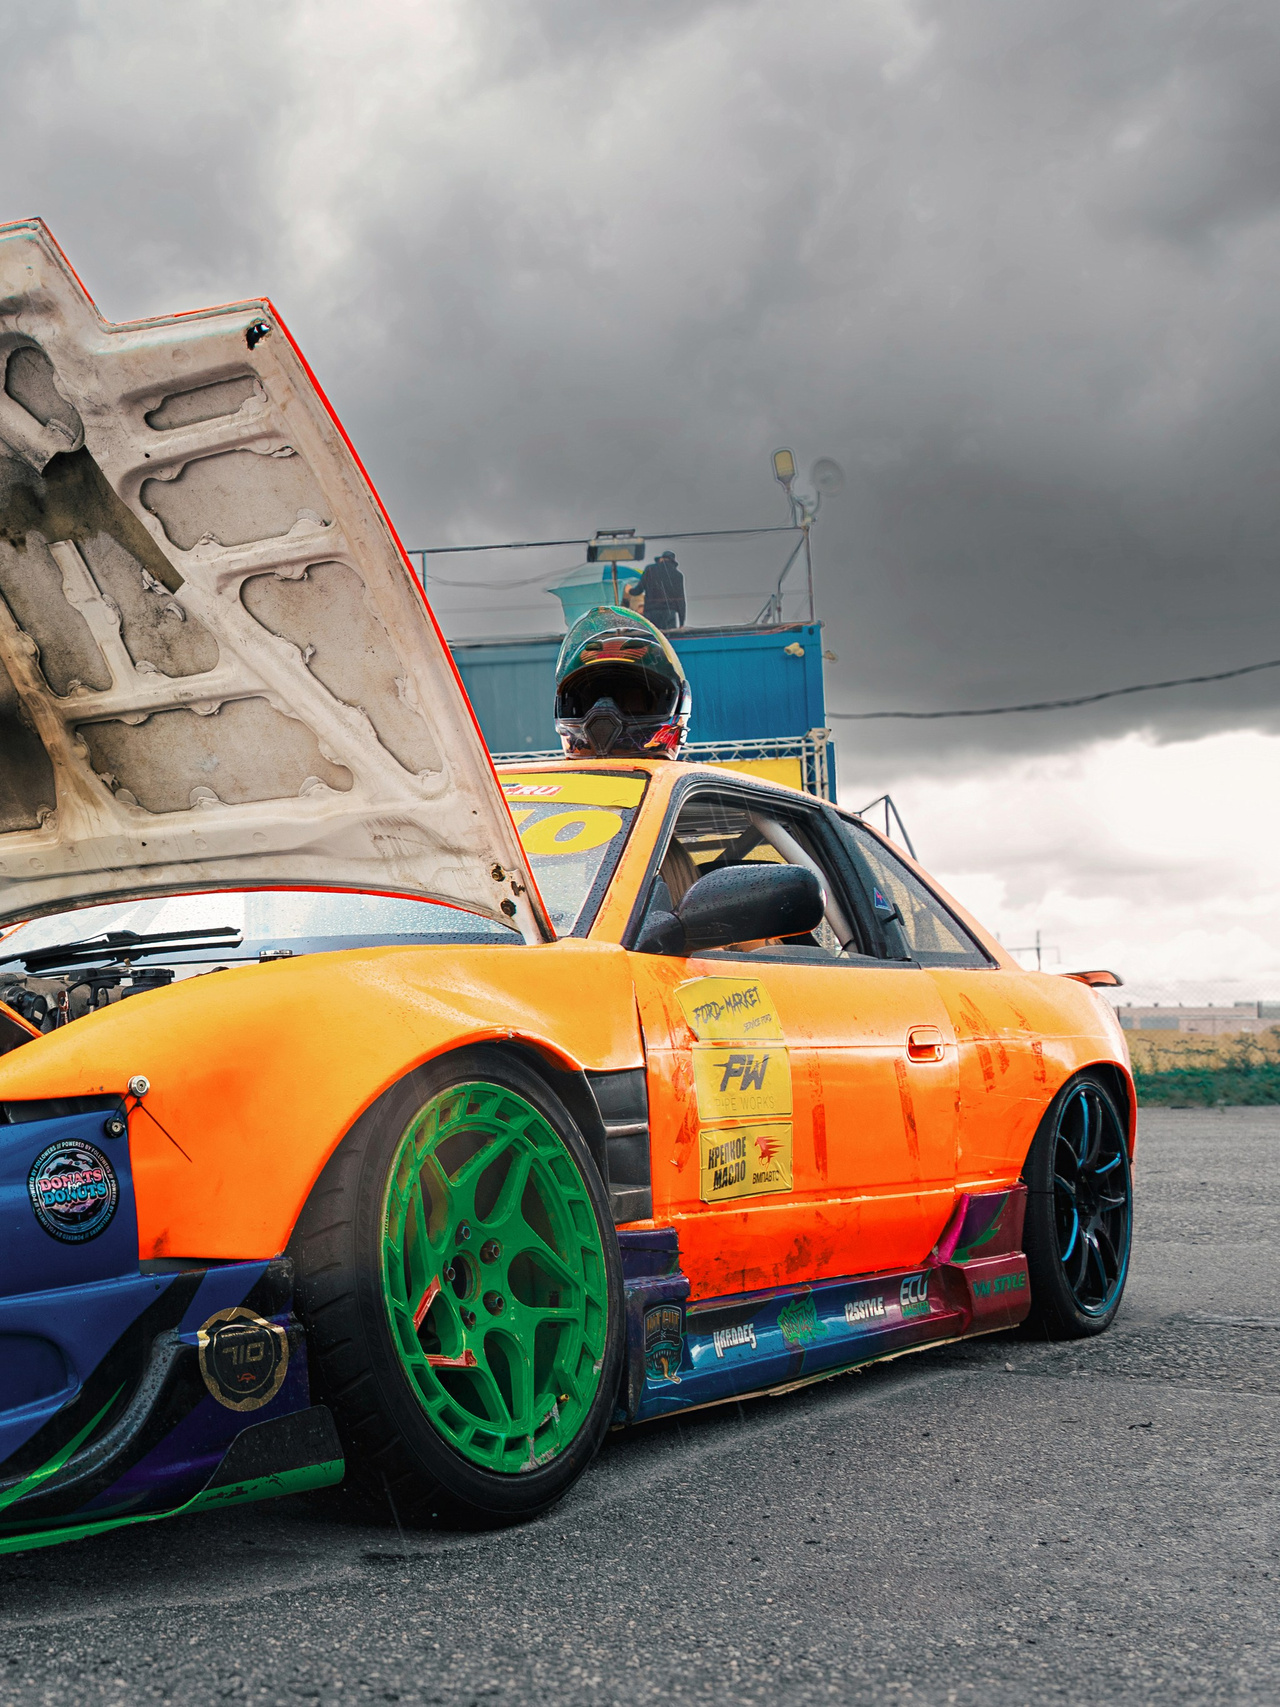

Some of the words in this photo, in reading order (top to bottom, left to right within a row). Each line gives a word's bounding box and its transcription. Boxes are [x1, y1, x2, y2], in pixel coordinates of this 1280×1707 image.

[511, 809, 623, 855] 0
[692, 986, 761, 1027] FORD-MARKET
[713, 1054, 771, 1092] PW
[740, 1096, 775, 1110] WORKS
[34, 1145, 56, 1168] FOLLOWERS
[61, 1141, 85, 1149] POWERED
[91, 1147, 111, 1174] FOLLOWERS
[708, 1136, 746, 1170] КРЕПКОЕ
[39, 1169, 102, 1191] DONATS
[713, 1160, 746, 1191] МАСЛО
[752, 1170, 780, 1184] ВМПАВТО
[43, 1182, 107, 1205] DONUTS
[901, 1270, 931, 1305] ECU
[973, 1279, 991, 1297] VM
[994, 1273, 1026, 1293] STYLE
[845, 1297, 885, 1322] 125STYLE
